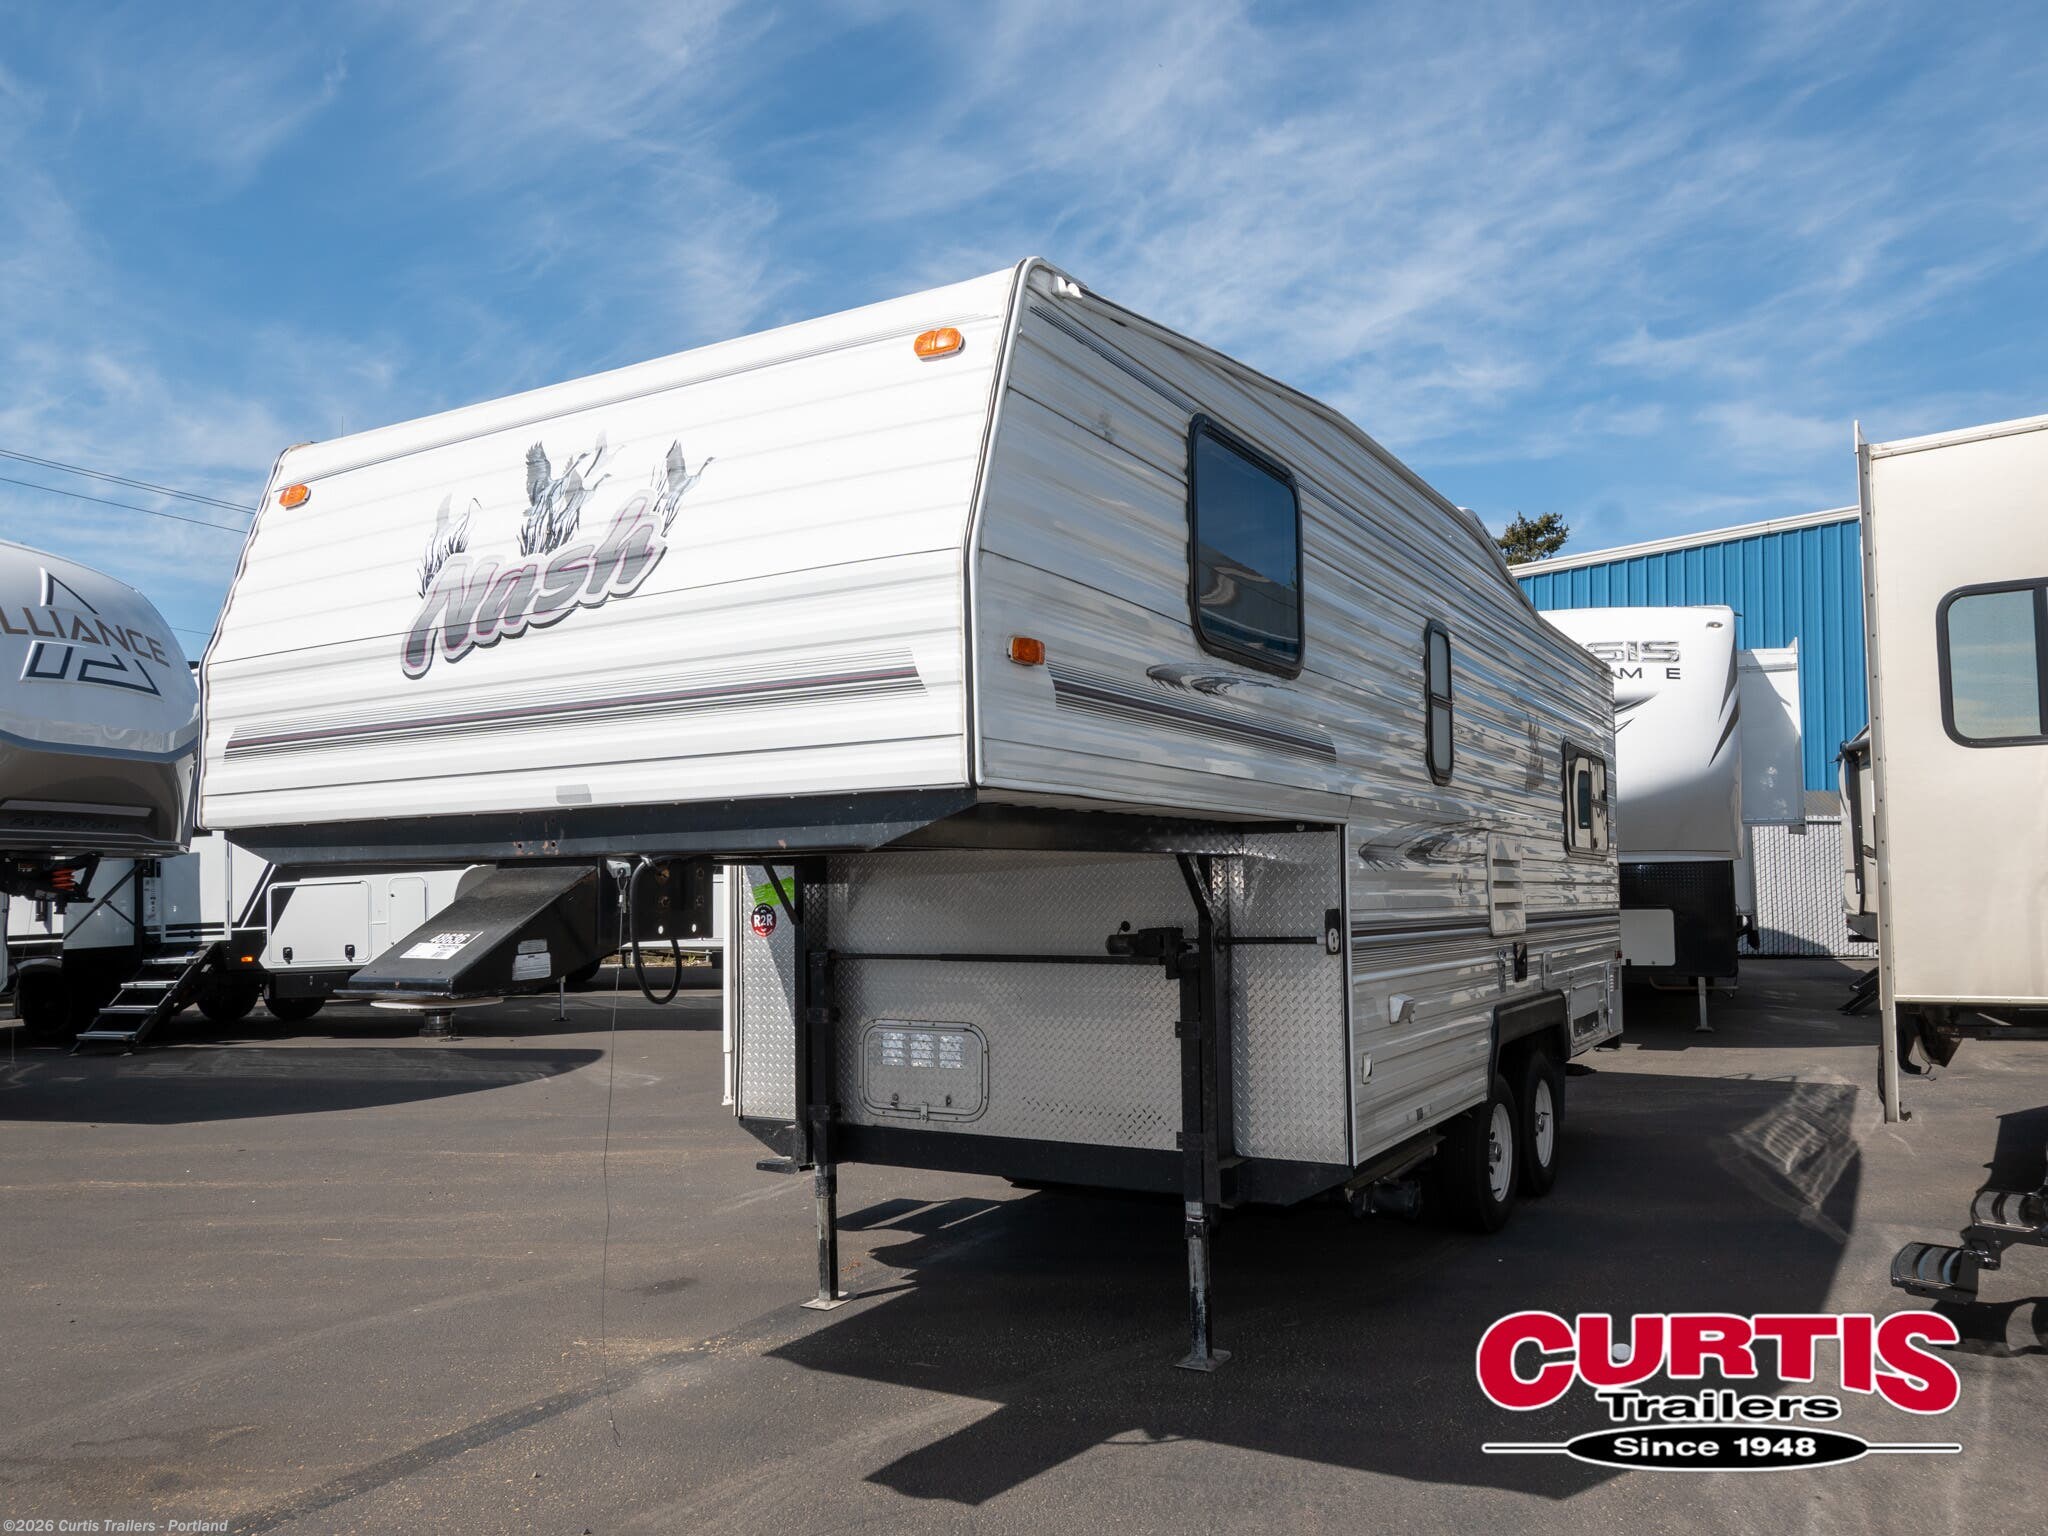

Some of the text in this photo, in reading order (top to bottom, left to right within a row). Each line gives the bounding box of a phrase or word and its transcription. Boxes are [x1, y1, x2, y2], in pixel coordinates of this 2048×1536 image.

[402, 491, 665, 676] Nash
[0, 606, 170, 668] LLIANCE
[1586, 641, 1680, 662] SIS
[753, 913, 773, 928] R2R
